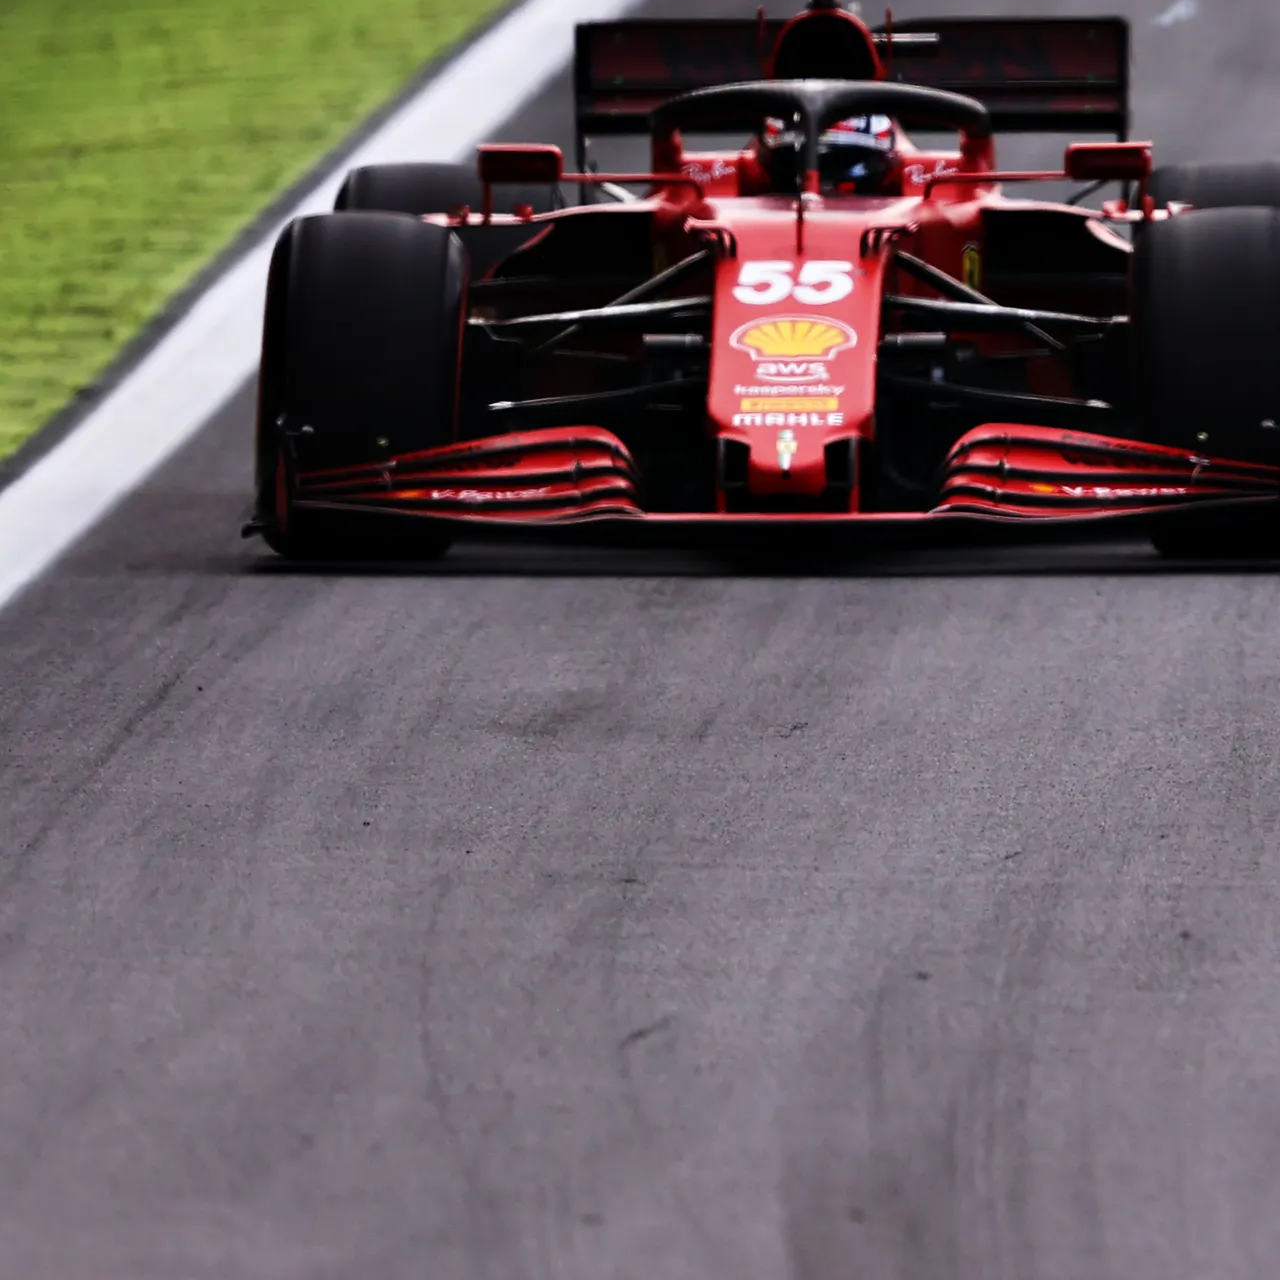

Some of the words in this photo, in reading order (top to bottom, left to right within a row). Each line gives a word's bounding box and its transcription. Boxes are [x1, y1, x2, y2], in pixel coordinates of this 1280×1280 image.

[732, 260, 854, 305] 55
[755, 362, 827, 376] aws
[733, 384, 845, 396] kaspersky
